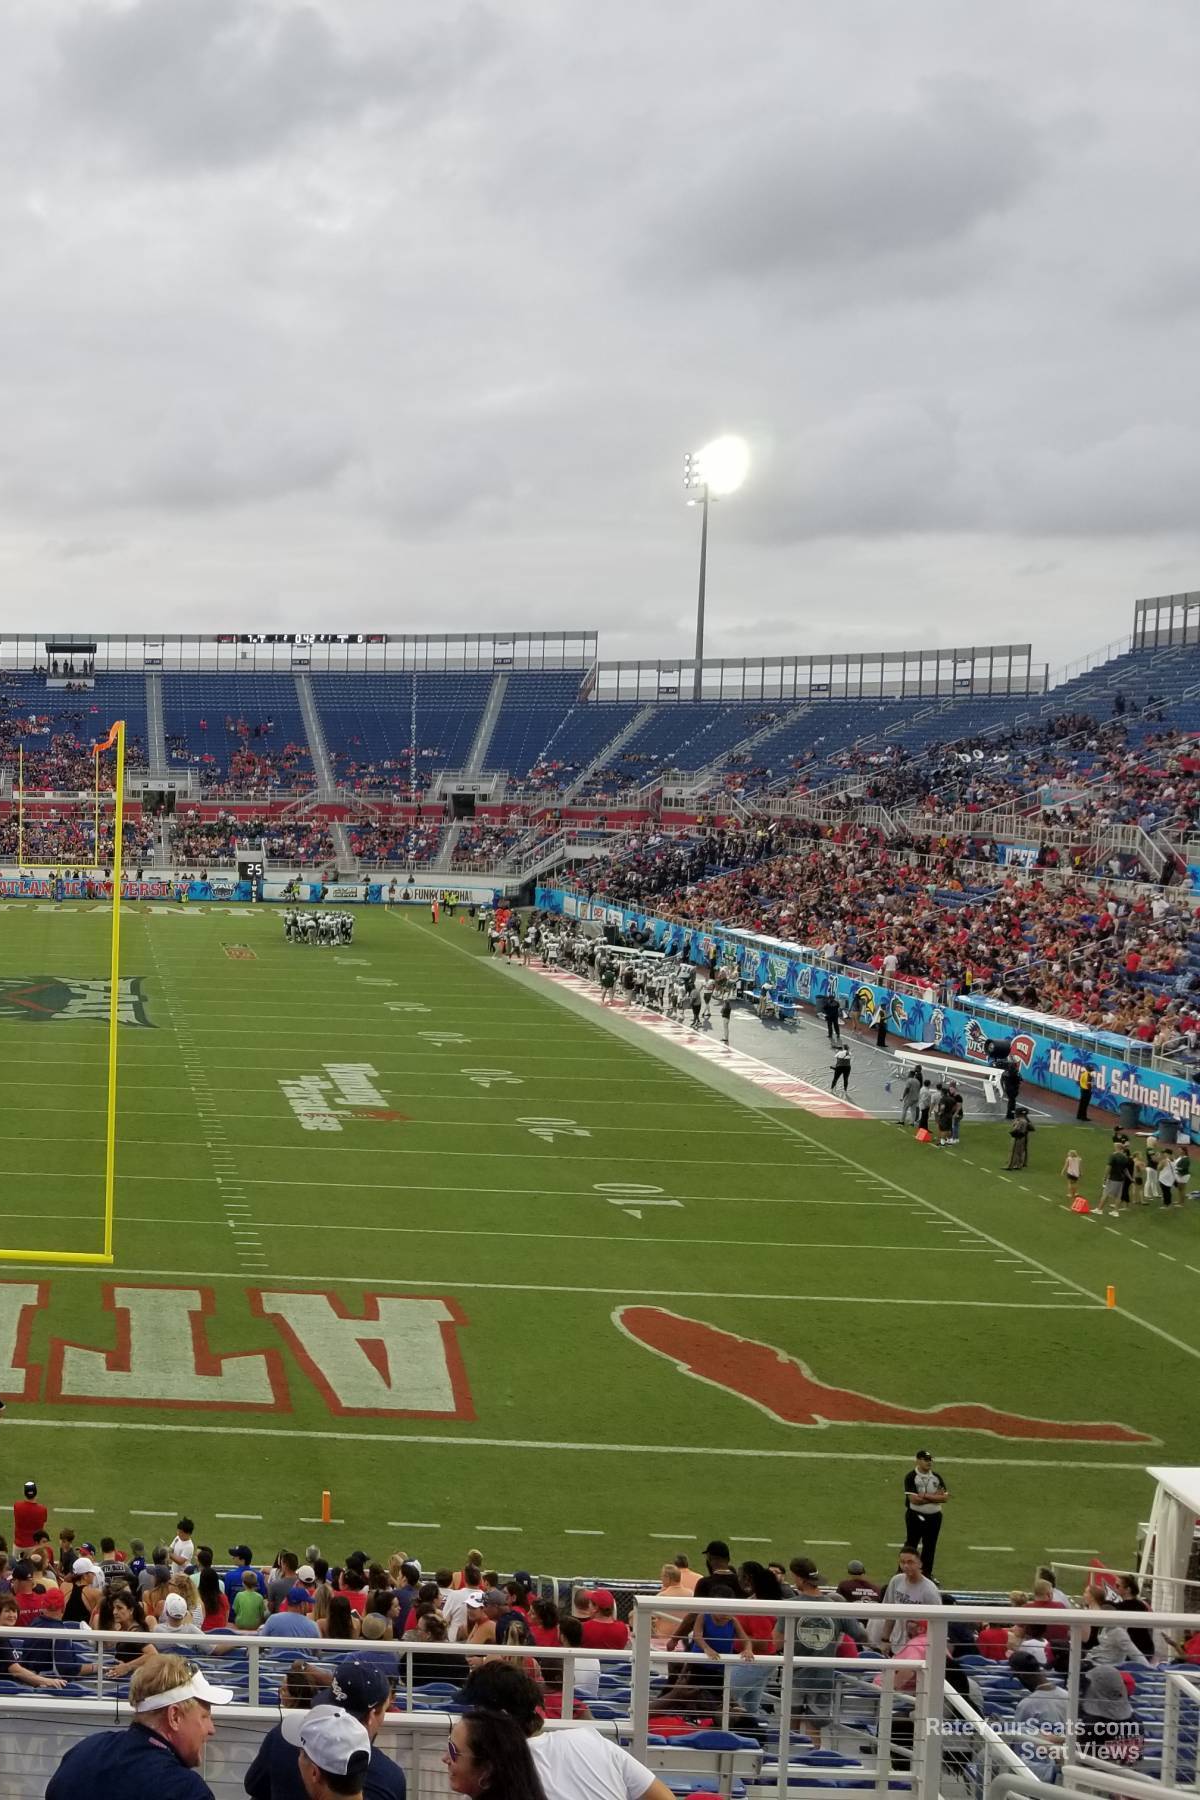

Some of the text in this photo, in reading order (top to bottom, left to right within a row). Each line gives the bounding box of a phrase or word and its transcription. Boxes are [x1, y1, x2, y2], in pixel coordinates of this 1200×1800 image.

[247, 863, 262, 875] 25
[414, 888, 439, 900] FUNKY
[516, 1116, 593, 1138] 20
[592, 1182, 685, 1209] 10
